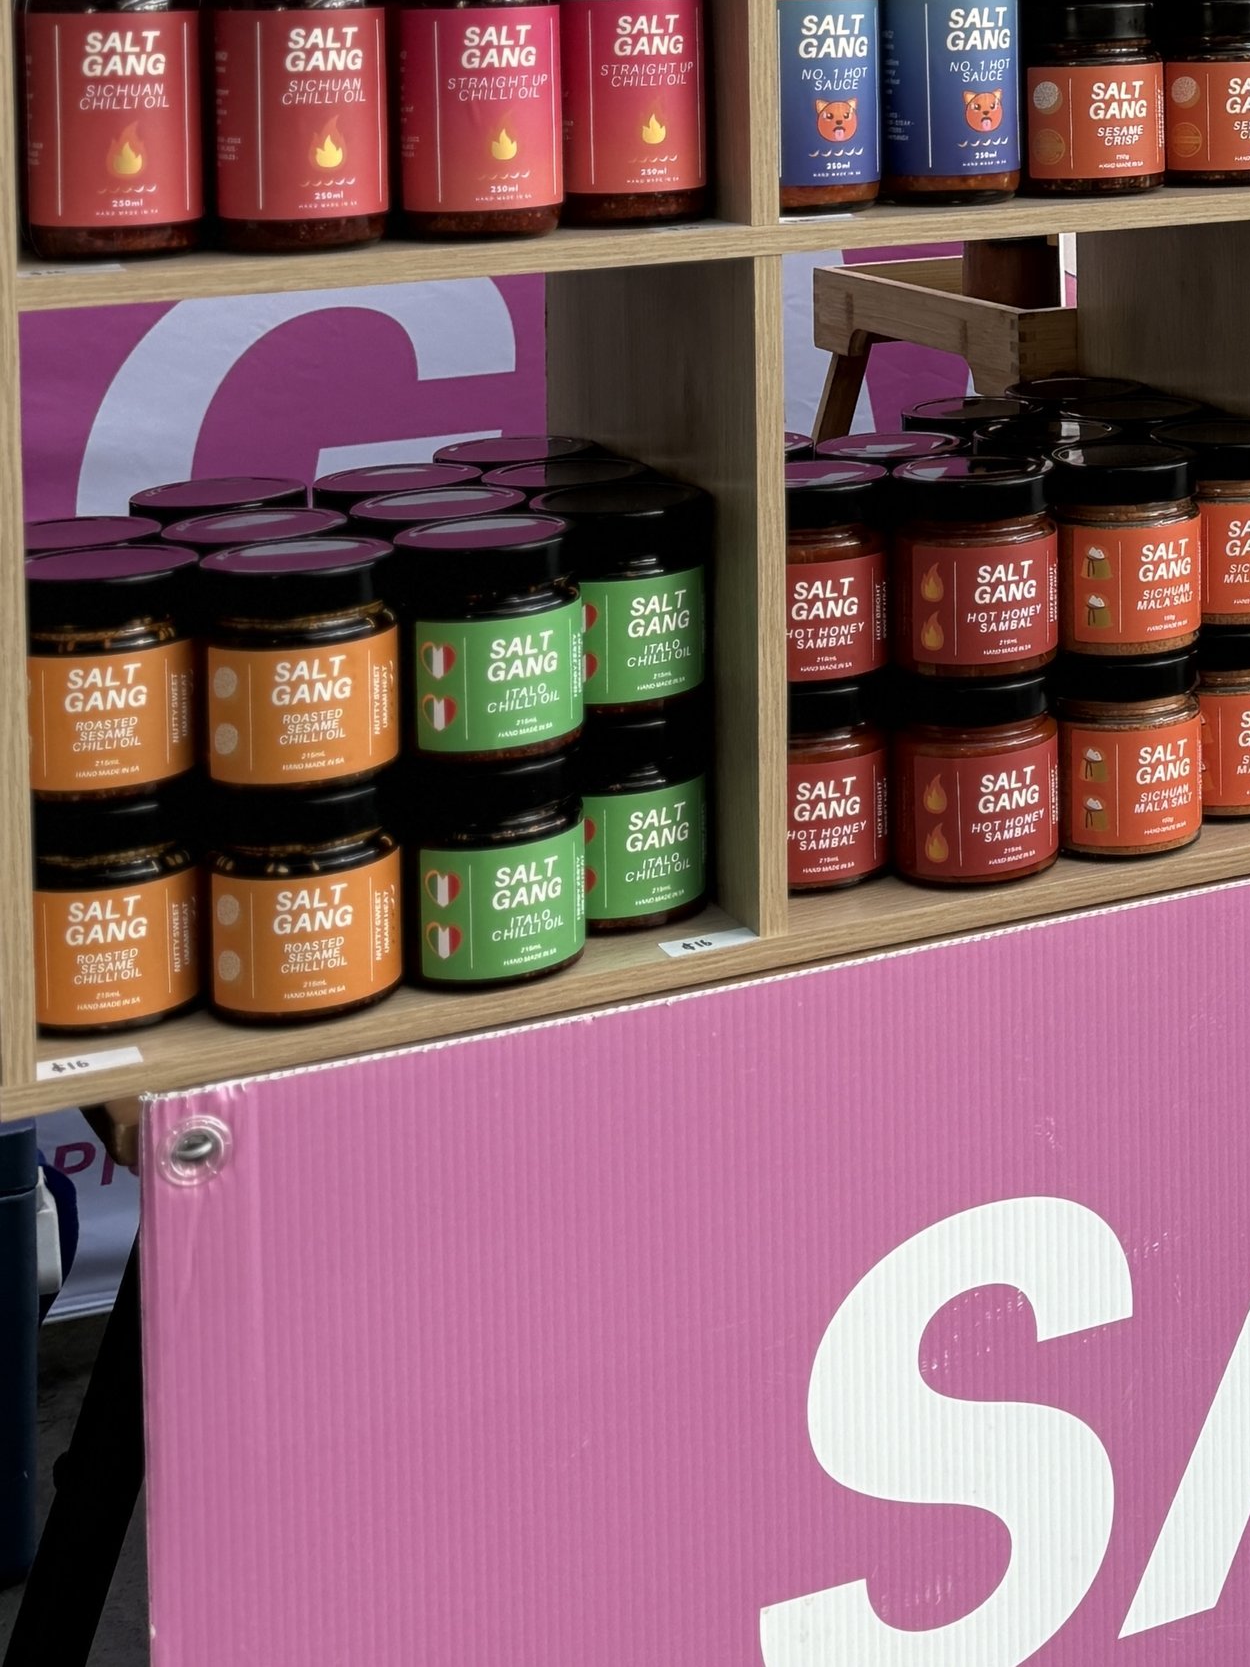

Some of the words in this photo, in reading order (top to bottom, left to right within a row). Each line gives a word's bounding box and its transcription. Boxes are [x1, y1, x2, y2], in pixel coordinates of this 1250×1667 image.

[463, 24, 531, 46] SALT
[801, 14, 864, 36] SALT
[84, 30, 161, 54] SALT
[799, 37, 868, 58] GANG
[82, 53, 166, 77] GANG
[461, 46, 537, 68] GANG
[448, 76, 529, 90] STRAIGHT
[532, 73, 548, 86] UP
[802, 69, 826, 80] NO.
[844, 67, 868, 78] HOT
[85, 83, 164, 97] SICHUAN
[459, 88, 514, 102] CHILLI
[518, 86, 540, 100] OIL
[815, 79, 859, 91] SAUCE
[79, 96, 138, 111] CHILLI
[145, 95, 170, 109] OIL
[1140, 538, 1189, 562] SALT
[977, 560, 1034, 583] SALT
[1138, 558, 1191, 583] GANG
[974, 580, 1036, 604] GANG
[1143, 582, 1191, 599] SICHUAN
[1137, 596, 1171, 611] MALA
[1173, 592, 1193, 605] SALT
[967, 610, 998, 623] HOT
[1000, 603, 1042, 619] HONEY
[979, 617, 1032, 633] SAMBAL
[490, 630, 553, 659] SALT
[274, 655, 347, 682] SALT
[487, 651, 558, 682] GANG
[272, 677, 352, 706] GANG
[505, 683, 547, 700] ITALO
[283, 709, 343, 724] ROASTED
[287, 719, 339, 734] SESAME
